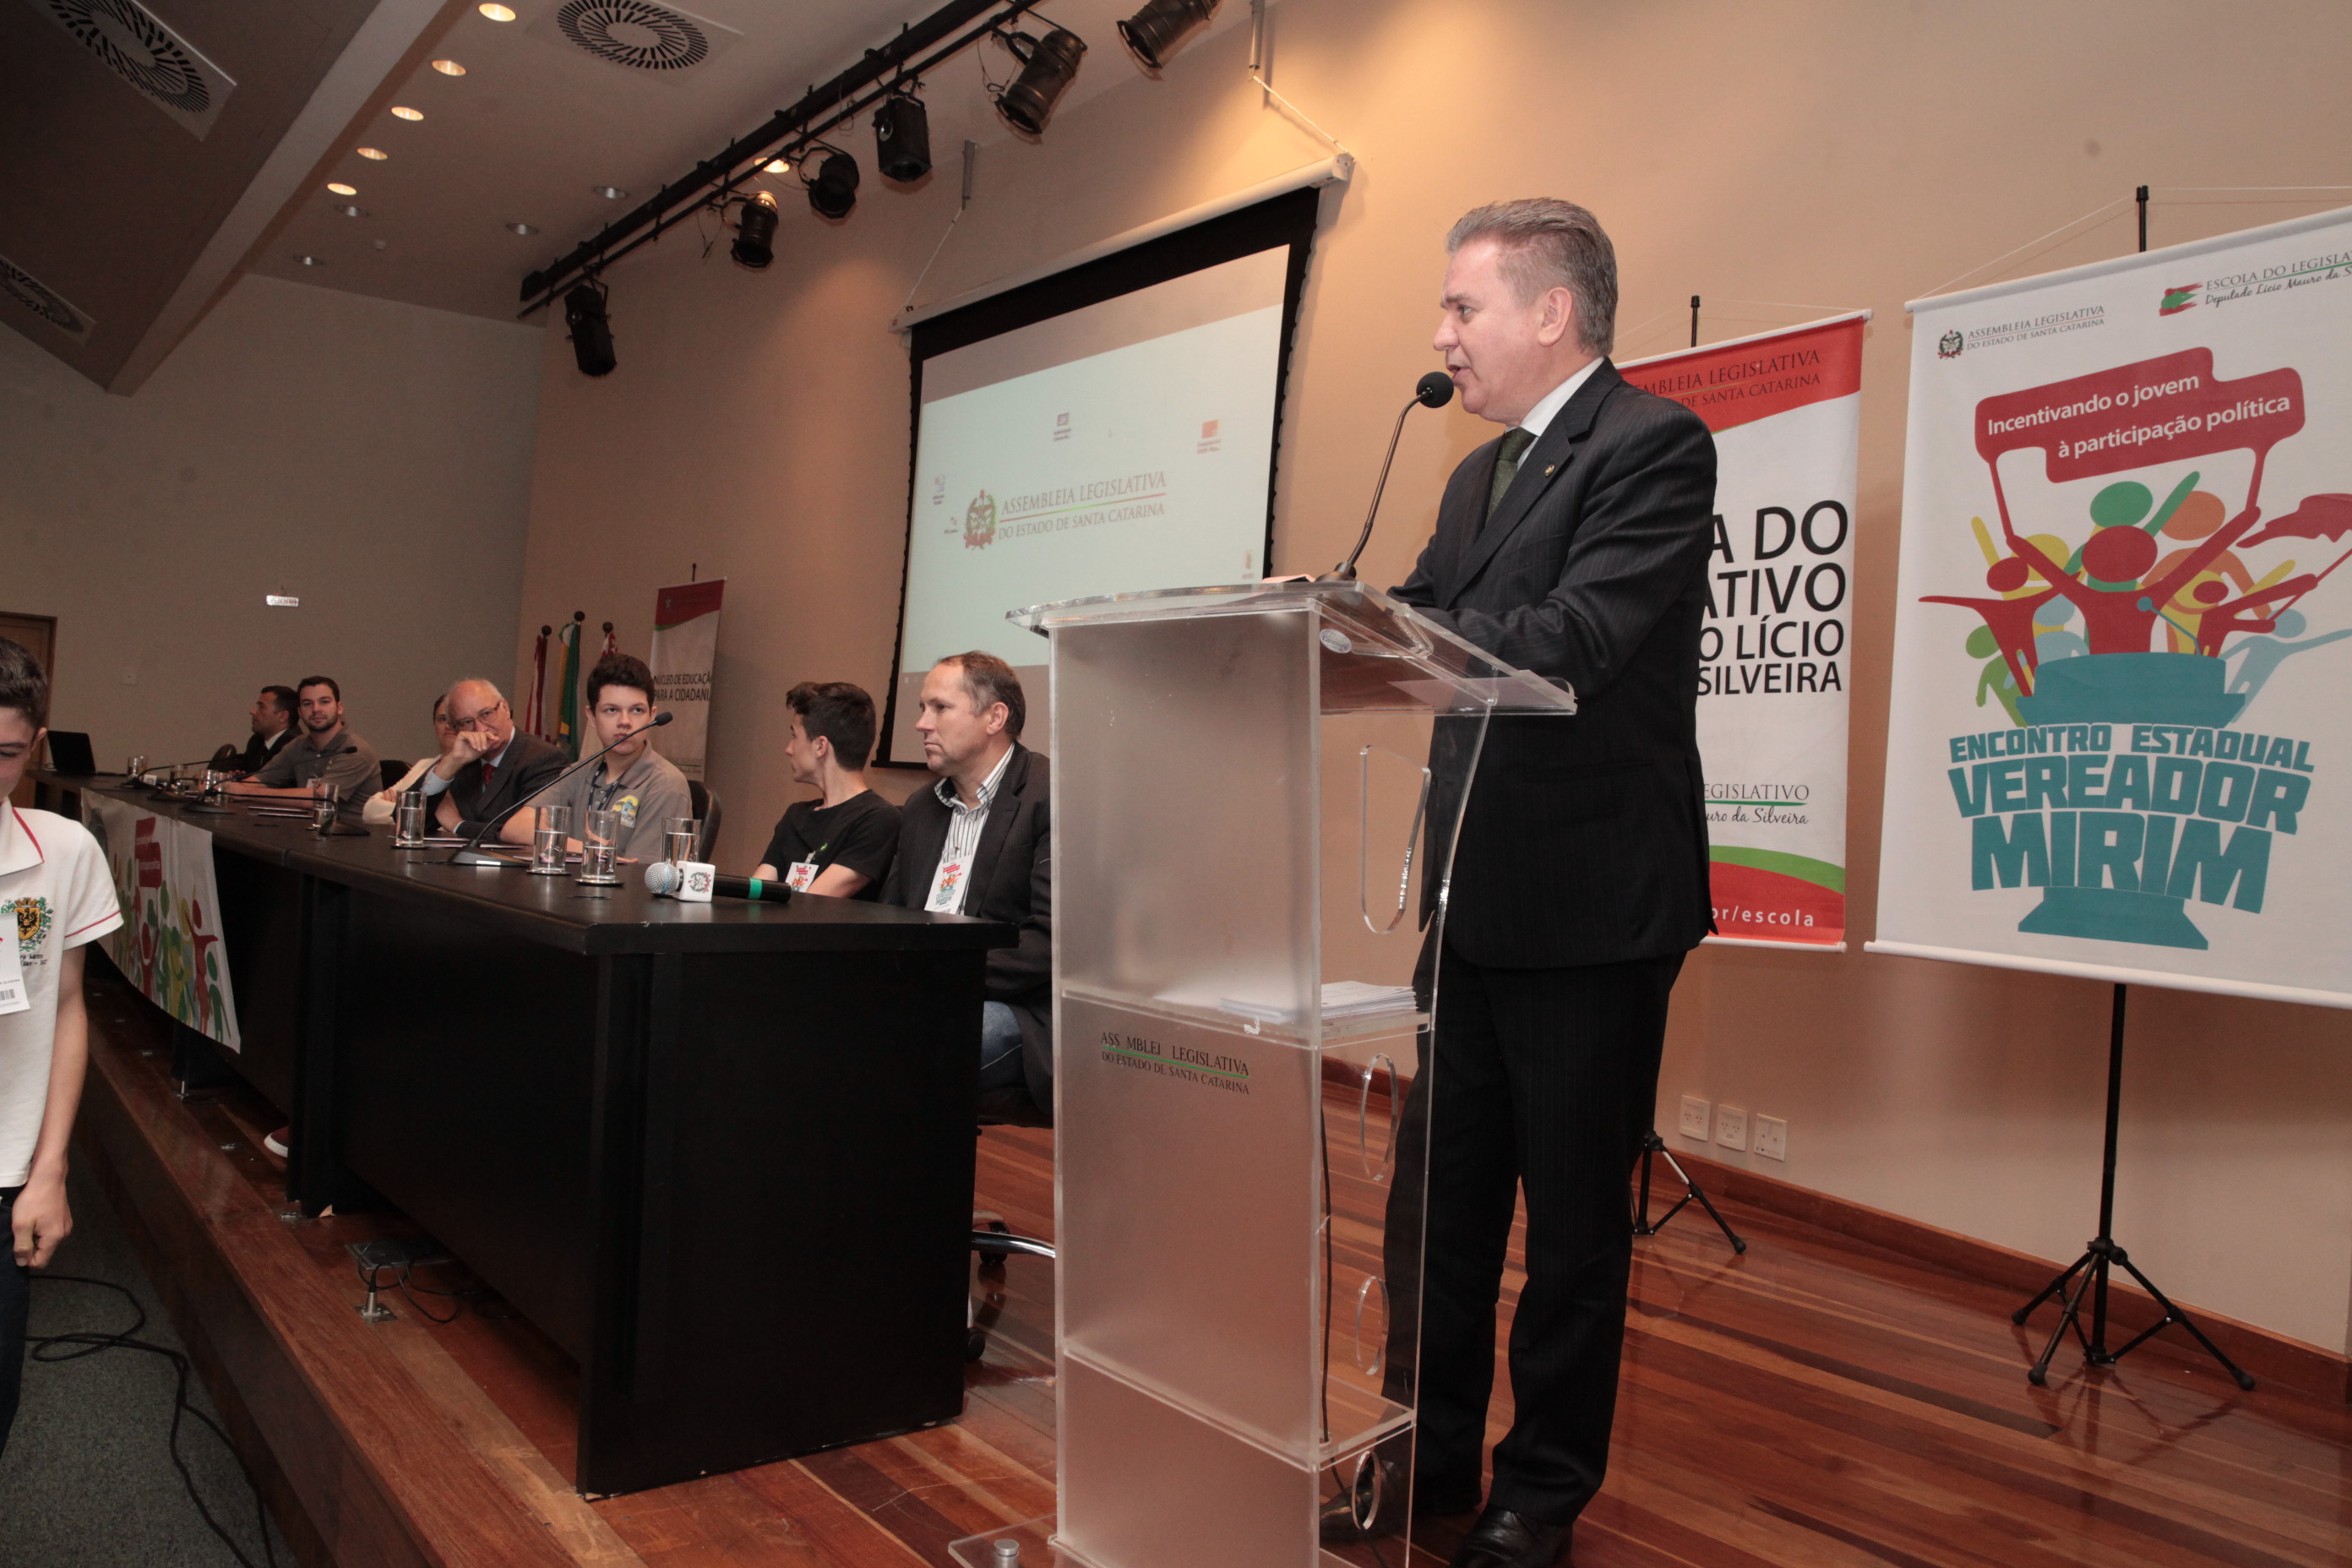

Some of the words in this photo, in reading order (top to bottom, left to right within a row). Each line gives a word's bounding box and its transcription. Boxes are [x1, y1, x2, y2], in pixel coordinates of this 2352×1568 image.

[2205, 286, 2252, 308] Deputado
[2284, 275, 2322, 290] Mauro
[2325, 268, 2341, 281] da
[2206, 271, 2258, 291] ESCOLA
[2262, 264, 2287, 280] DO
[2291, 250, 2352, 274] LEGISLA
[1967, 341, 1980, 351] DO
[1982, 335, 2014, 347] ESTADO
[2016, 333, 2028, 341] DE
[2030, 329, 2057, 340] SANTA
[2059, 318, 2104, 333] CATARINA
[1968, 319, 2031, 340] ASSEMBLEIA
[2034, 305, 2104, 327] LEGISLATIVA
[1709, 350, 1821, 385] LEGISLATIVA
[1701, 385, 1745, 406] SANTA
[1749, 373, 1821, 397] CATARINA
[1987, 393, 2112, 436] Incentivando
[2115, 391, 2130, 406] o
[2131, 374, 2200, 408] jovem
[2058, 439, 2072, 458] à
[2073, 413, 2202, 460] participação
[2206, 395, 2291, 433] política
[1001, 487, 1075, 515] ASSEMBLEIA
[1080, 471, 1167, 502] LEGISLATIVA
[998, 526, 1014, 541] DO
[1015, 520, 1054, 537] ESTADO
[1056, 516, 1069, 531] DE
[1072, 512, 1106, 529] SANTA
[1108, 503, 1165, 523] CATARINA
[1755, 500, 1848, 560] DO
[1736, 614, 1844, 661] LÍCIO
[674, 673, 681, 684] DE
[1696, 662, 1842, 696] SILVEIRA
[1949, 724, 2112, 764] ENCONTRO
[2131, 724, 2315, 773] ESTADUAL
[1731, 805, 1749, 823] da
[1752, 805, 1810, 825] Silveira
[1947, 754, 2311, 836] VEREADOR
[1971, 811, 2273, 914] MIRIM
[1102, 1051, 1114, 1064] DO
[1116, 1054, 1152, 1071] ESTADO
[1154, 1063, 1167, 1075] DE
[1168, 1067, 1199, 1083] SANTA
[1200, 1074, 1250, 1095] CATARINA
[1172, 1045, 1250, 1076] LEGISLATIVA
